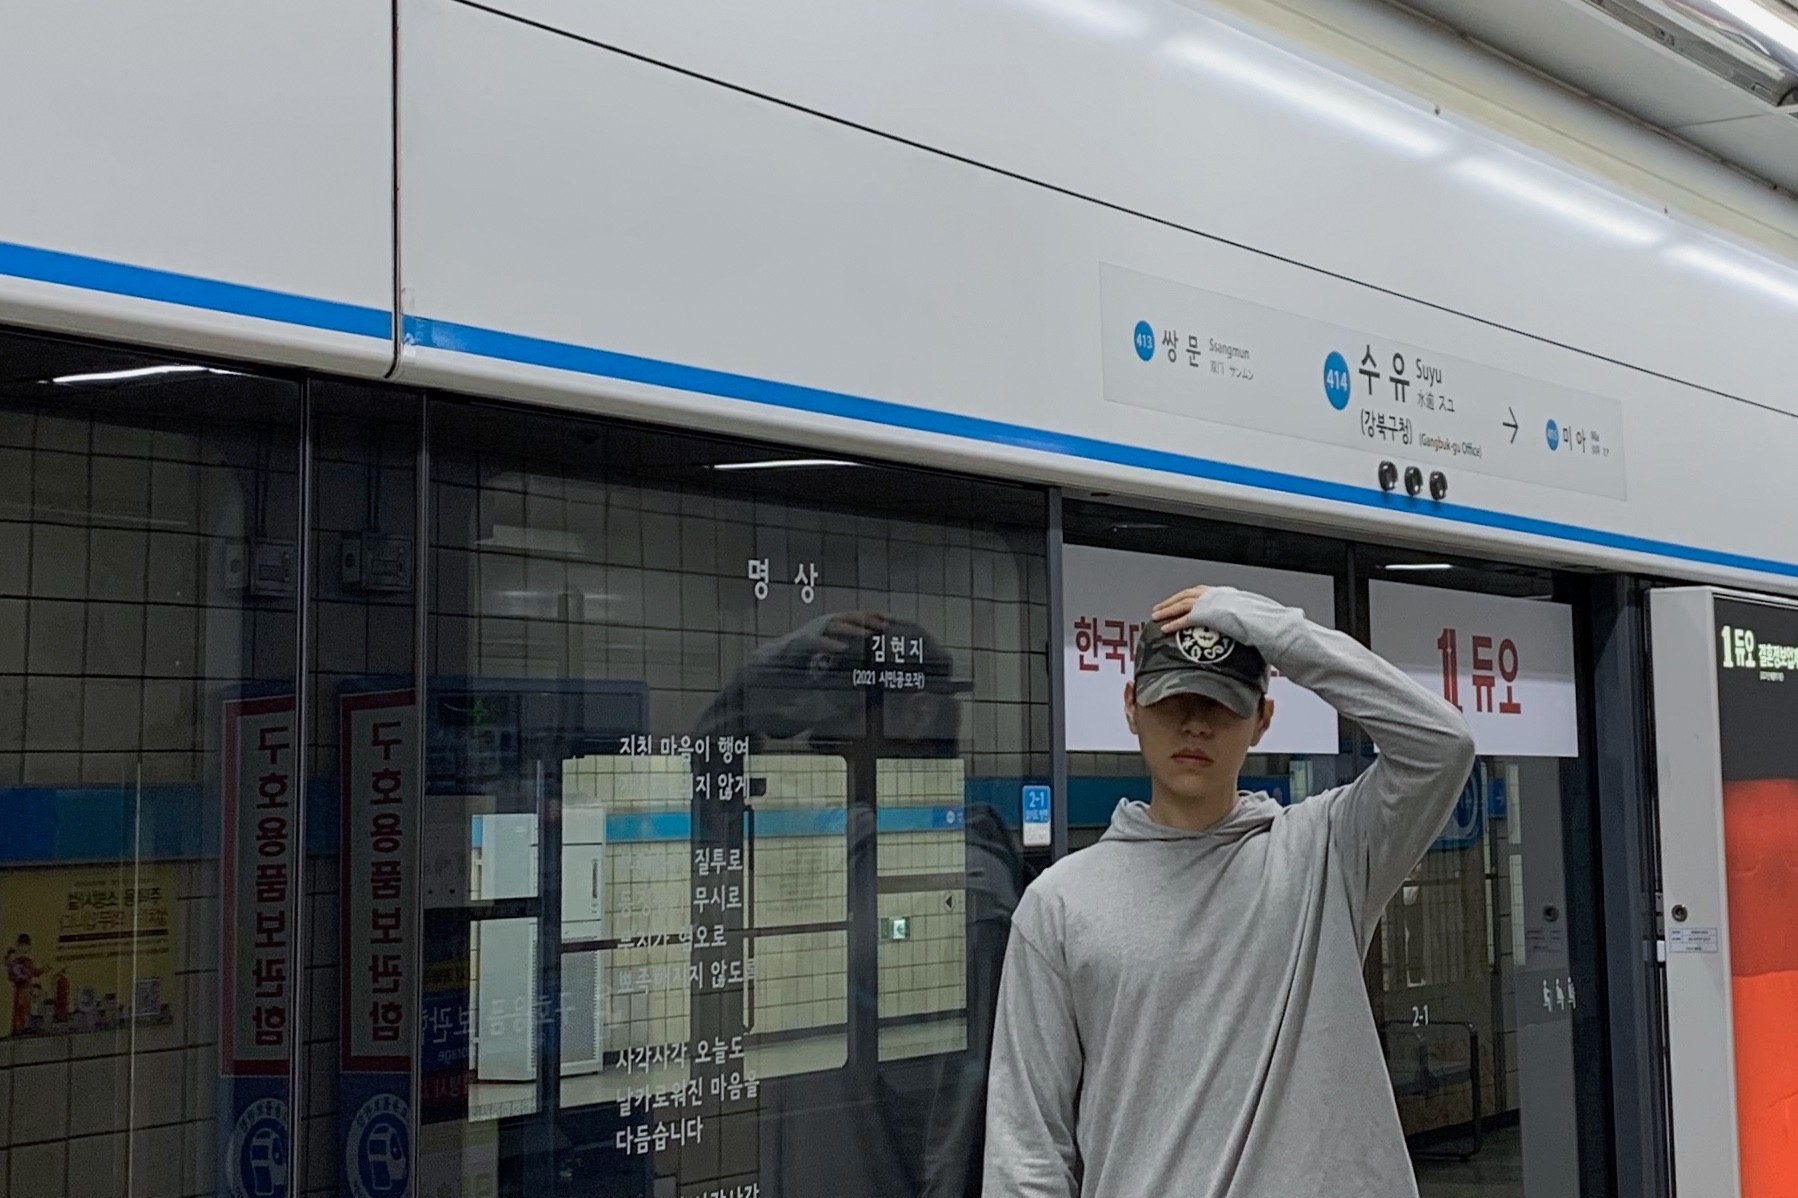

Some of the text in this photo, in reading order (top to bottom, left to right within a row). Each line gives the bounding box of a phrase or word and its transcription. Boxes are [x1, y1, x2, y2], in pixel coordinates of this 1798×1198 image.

[1136, 333, 1153, 350] 413
[1209, 337, 1250, 360] Ssangmun
[1326, 343, 1411, 403] 414 수유
[1416, 358, 1442, 387] Suyu
[1360, 408, 1413, 445] (강북구청)
[1562, 425, 1587, 454] 미아
[1461, 441, 1482, 459] Office)
[872, 634, 924, 664] 김현지
[853, 668, 925, 689] (2021 시민공모작)
[620, 734, 749, 764] 지친 마음이 행여
[717, 772, 750, 801] 않게
[1029, 791, 1045, 808] 2-1
[694, 847, 743, 876] 질투로
[693, 884, 743, 914] 무시로
[617, 958, 756, 996] 뾰족해지지 않도록
[1412, 1003, 1429, 1027] 2-1
[615, 1035, 745, 1075] 사각사각 오늘도
[616, 1070, 760, 1117] 날카로워진 마음을
[615, 1115, 704, 1155] 다듬습니다
